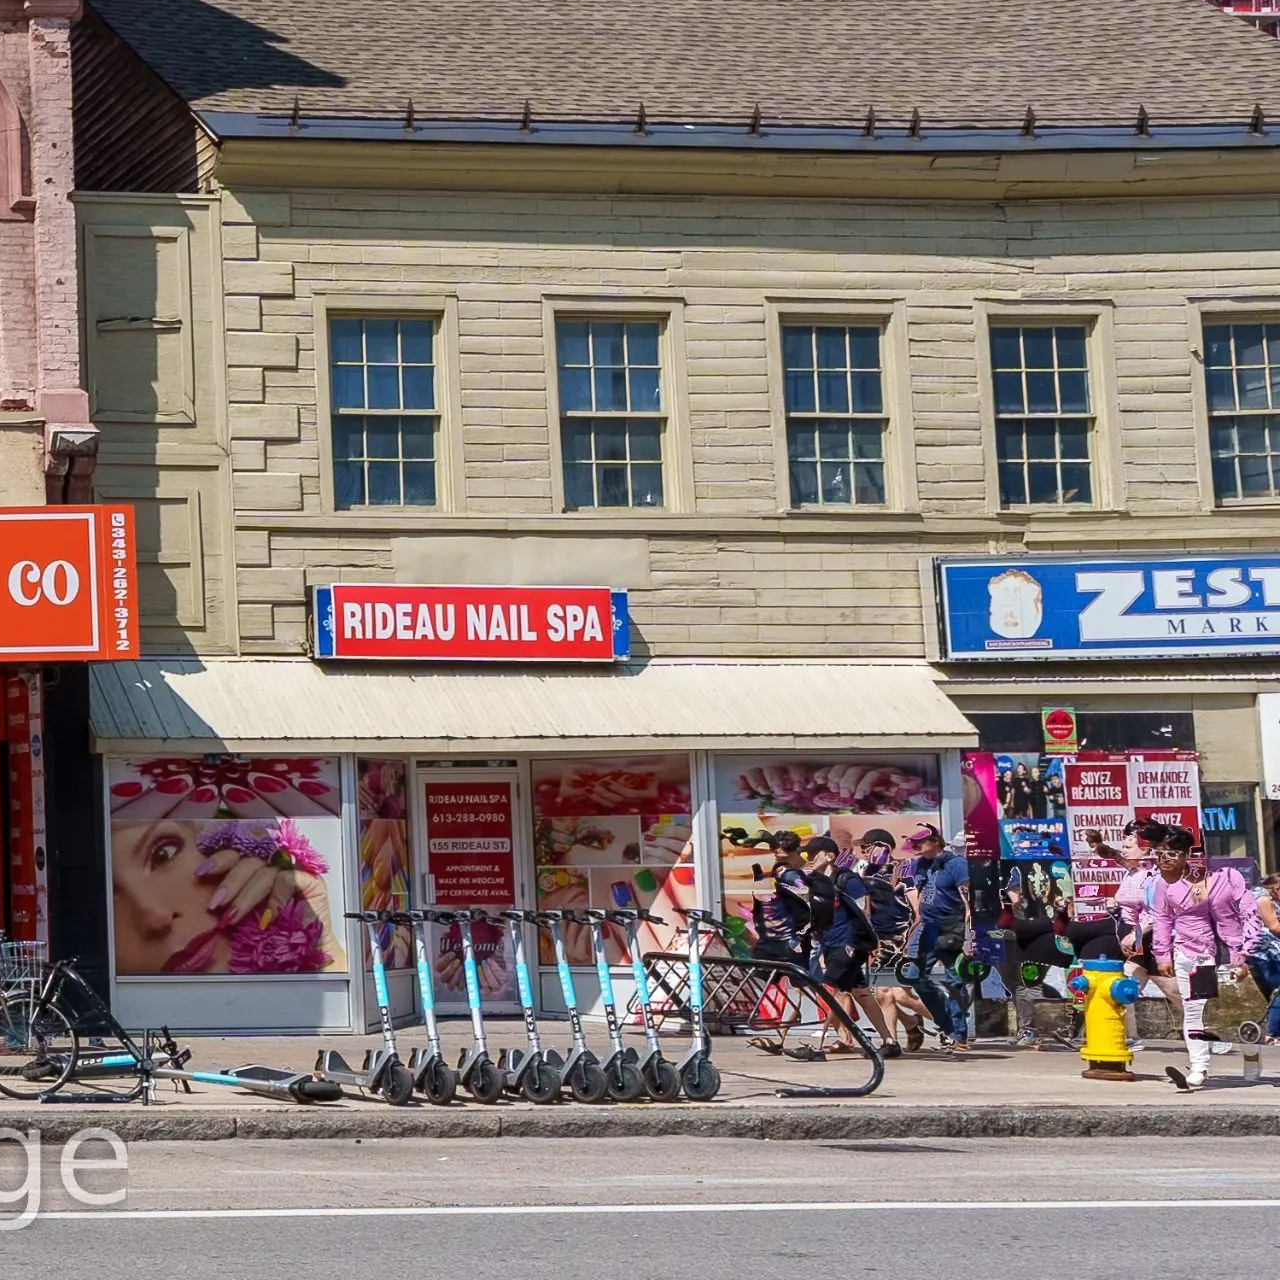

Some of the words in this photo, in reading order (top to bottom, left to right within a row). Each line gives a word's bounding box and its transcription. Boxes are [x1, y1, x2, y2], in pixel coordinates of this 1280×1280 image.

[7, 560, 80, 607] CO
[111, 527, 130, 651] 343-262-3712
[343, 602, 457, 641] RIDEAU
[466, 603, 538, 642] NAIL
[547, 604, 604, 643] SPA
[1080, 771, 1112, 785] SOYEZ
[1137, 771, 1189, 784] DEMANDEZ
[428, 795, 464, 804] RIDEAU
[465, 795, 488, 804] NAIL
[489, 794, 508, 803] SPA
[1137, 786, 1149, 799] LE
[432, 813, 505, 823] 613-288-0980
[1074, 814, 1125, 827] DEMANDEZ
[1200, 807, 1237, 831] ATM
[432, 842, 449, 851] 155
[451, 842, 490, 850] RIDEAU
[493, 841, 508, 850] ST.
[440, 939, 505, 952] Weome
